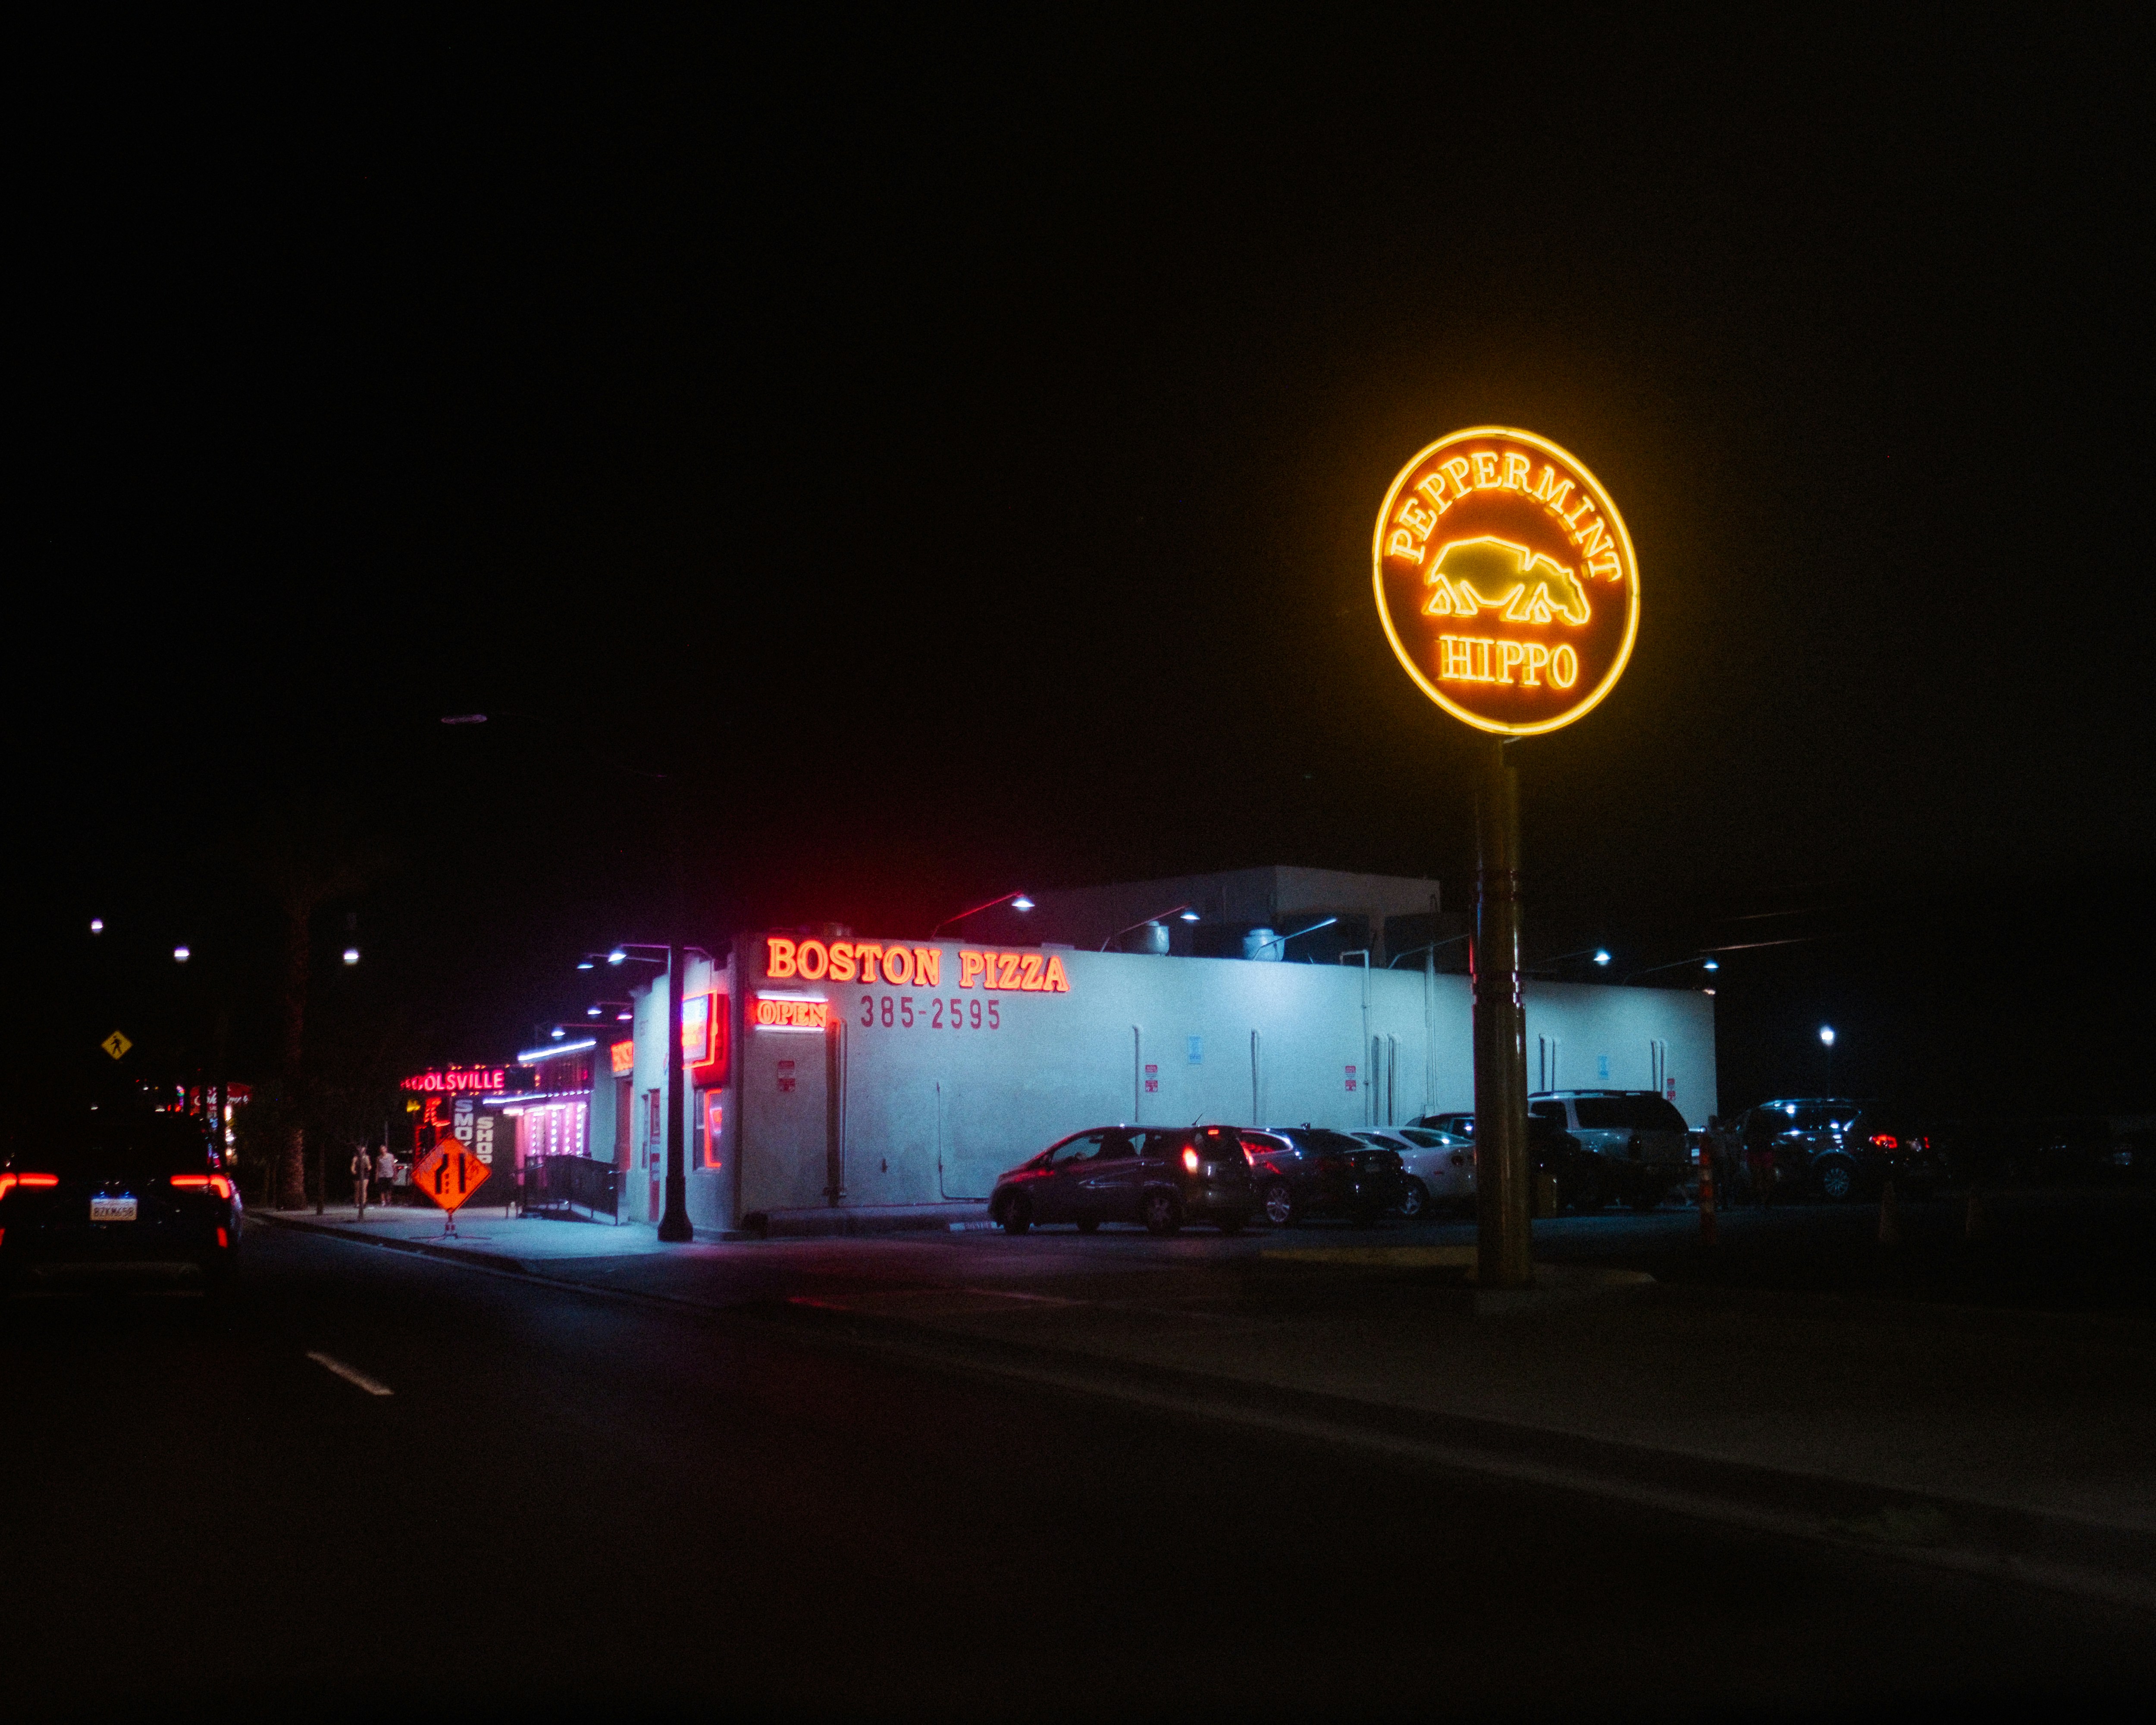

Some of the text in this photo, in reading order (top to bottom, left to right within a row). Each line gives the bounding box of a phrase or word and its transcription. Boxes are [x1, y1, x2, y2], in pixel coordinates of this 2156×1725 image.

[1385, 451, 1623, 582] PEPPERMINT
[1437, 635, 1579, 689] HIPPO
[767, 937, 1070, 992] BOSTON PIZZA
[757, 1000, 827, 1027] OPEN
[861, 996, 1000, 1030] 385-2595
[476, 1117, 493, 1164] SHOP
